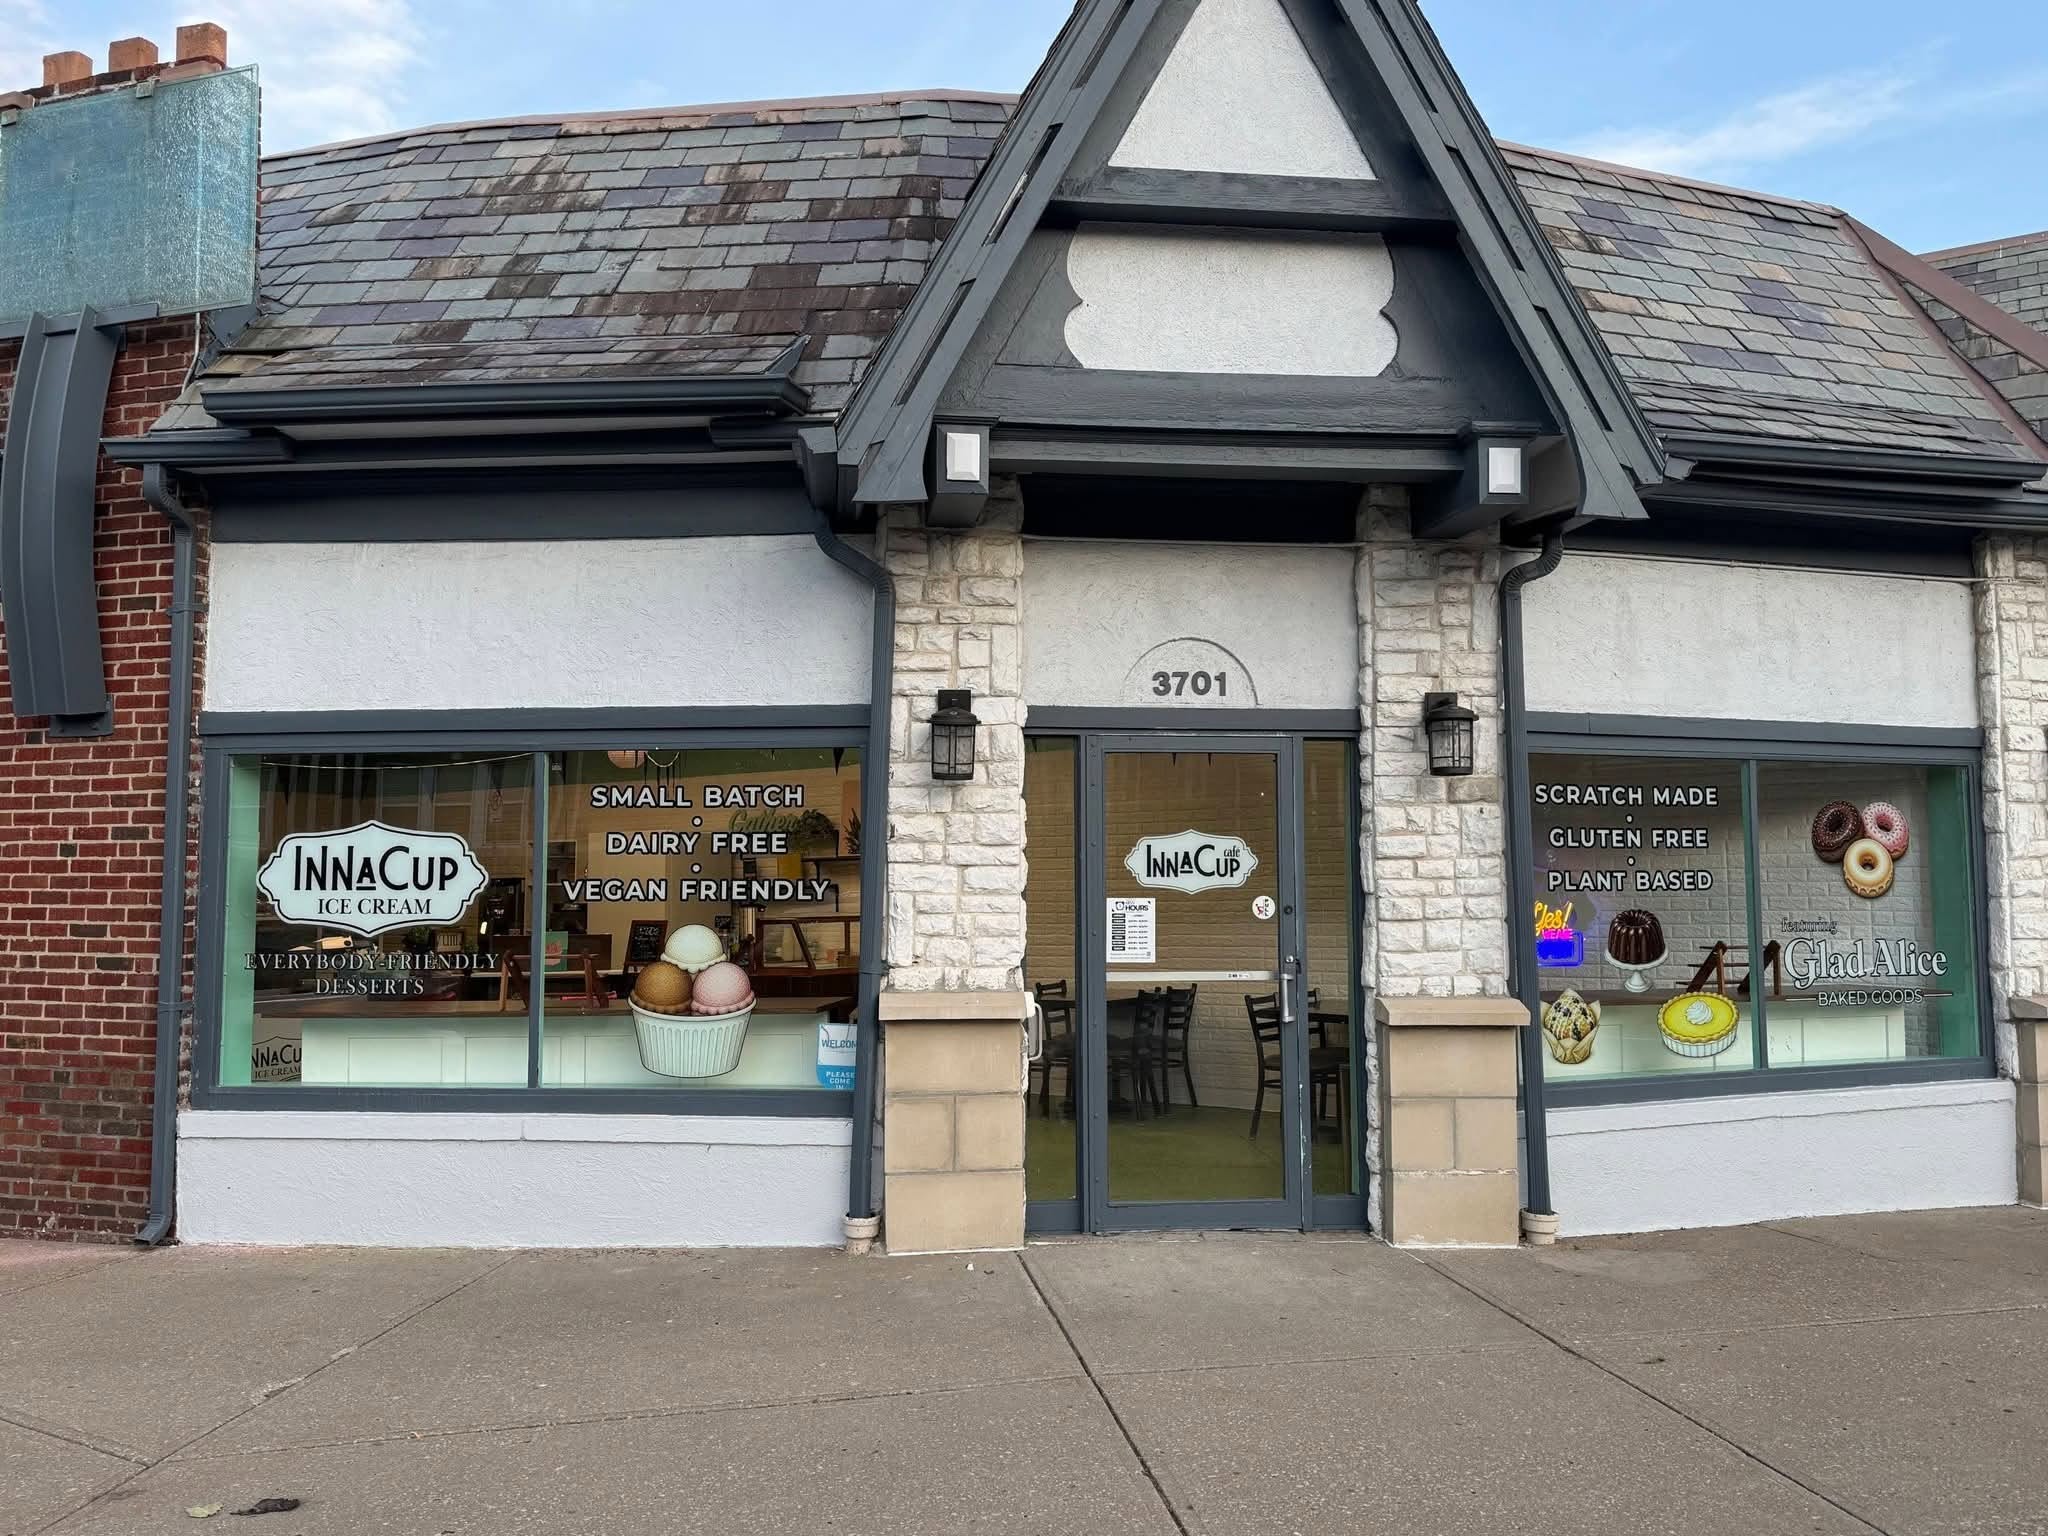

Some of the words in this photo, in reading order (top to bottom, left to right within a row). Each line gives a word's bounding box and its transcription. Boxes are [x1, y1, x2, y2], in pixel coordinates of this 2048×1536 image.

[1152, 671, 1227, 697] 3701
[591, 786, 692, 808] SMALL
[703, 785, 805, 808] BATCH
[1535, 785, 1644, 806] SCRATCH
[1653, 787, 1719, 806] MADE
[605, 832, 701, 855] DAIRY
[711, 832, 789, 854] FREE
[1549, 827, 1642, 849] GLUTEN
[1652, 829, 1709, 849] FREE
[562, 878, 668, 902] VEGAN
[680, 879, 831, 902] FRIENDLY
[1547, 871, 1627, 892] PLANT
[1636, 871, 1713, 892] BASED
[317, 898, 352, 915] ICE
[357, 898, 432, 915] CREAM
[1781, 917, 1839, 935] featuring
[244, 952, 499, 971] EVERYBODY-FRIENDLY
[1784, 938, 1867, 989] Glad
[1871, 938, 1949, 977] Alice
[314, 978, 425, 996] DESSERTS
[1817, 991, 1868, 1007] BAKED
[1871, 989, 1923, 1005] GOODS
[822, 1039, 857, 1048] WELCOM
